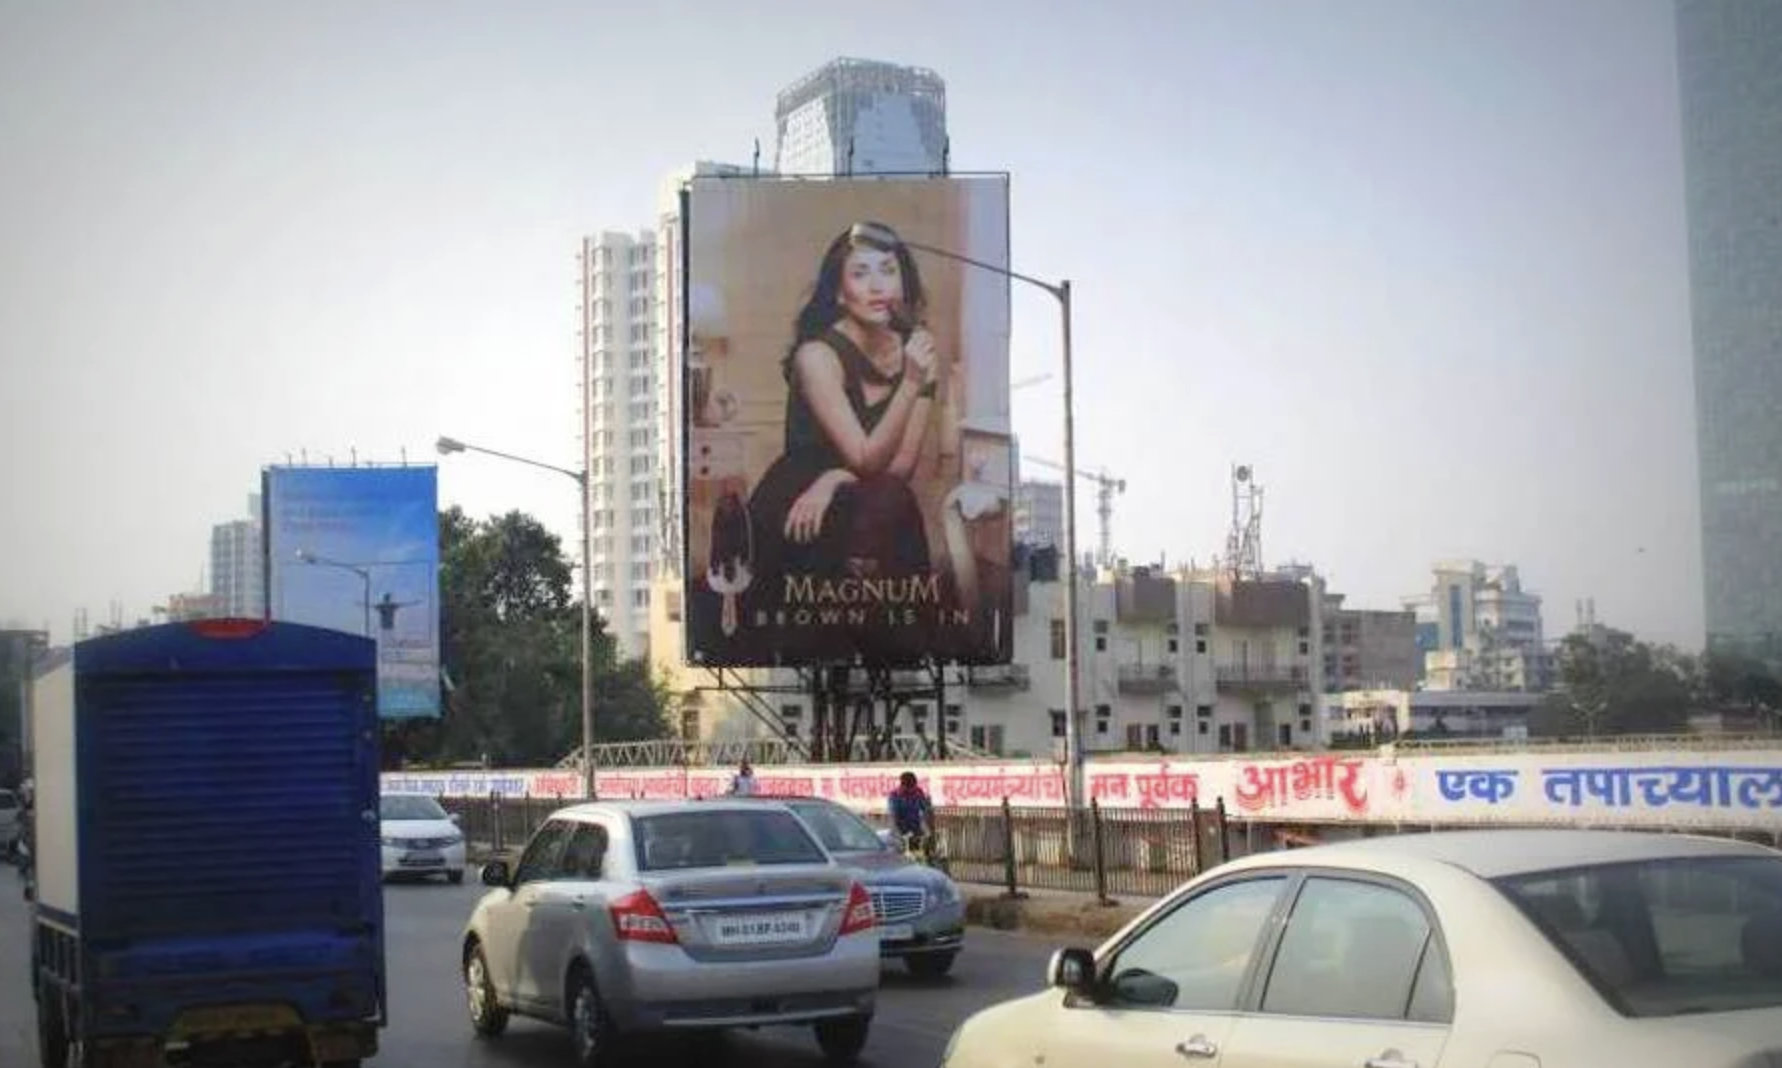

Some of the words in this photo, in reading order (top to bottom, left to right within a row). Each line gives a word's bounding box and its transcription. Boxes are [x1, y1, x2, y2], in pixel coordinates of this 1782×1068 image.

[756, 608, 865, 625] BROWN
[888, 608, 916, 625] IS
[939, 608, 970, 625] IN
[1236, 756, 1369, 813] आभार
[1435, 769, 1519, 803] एक
